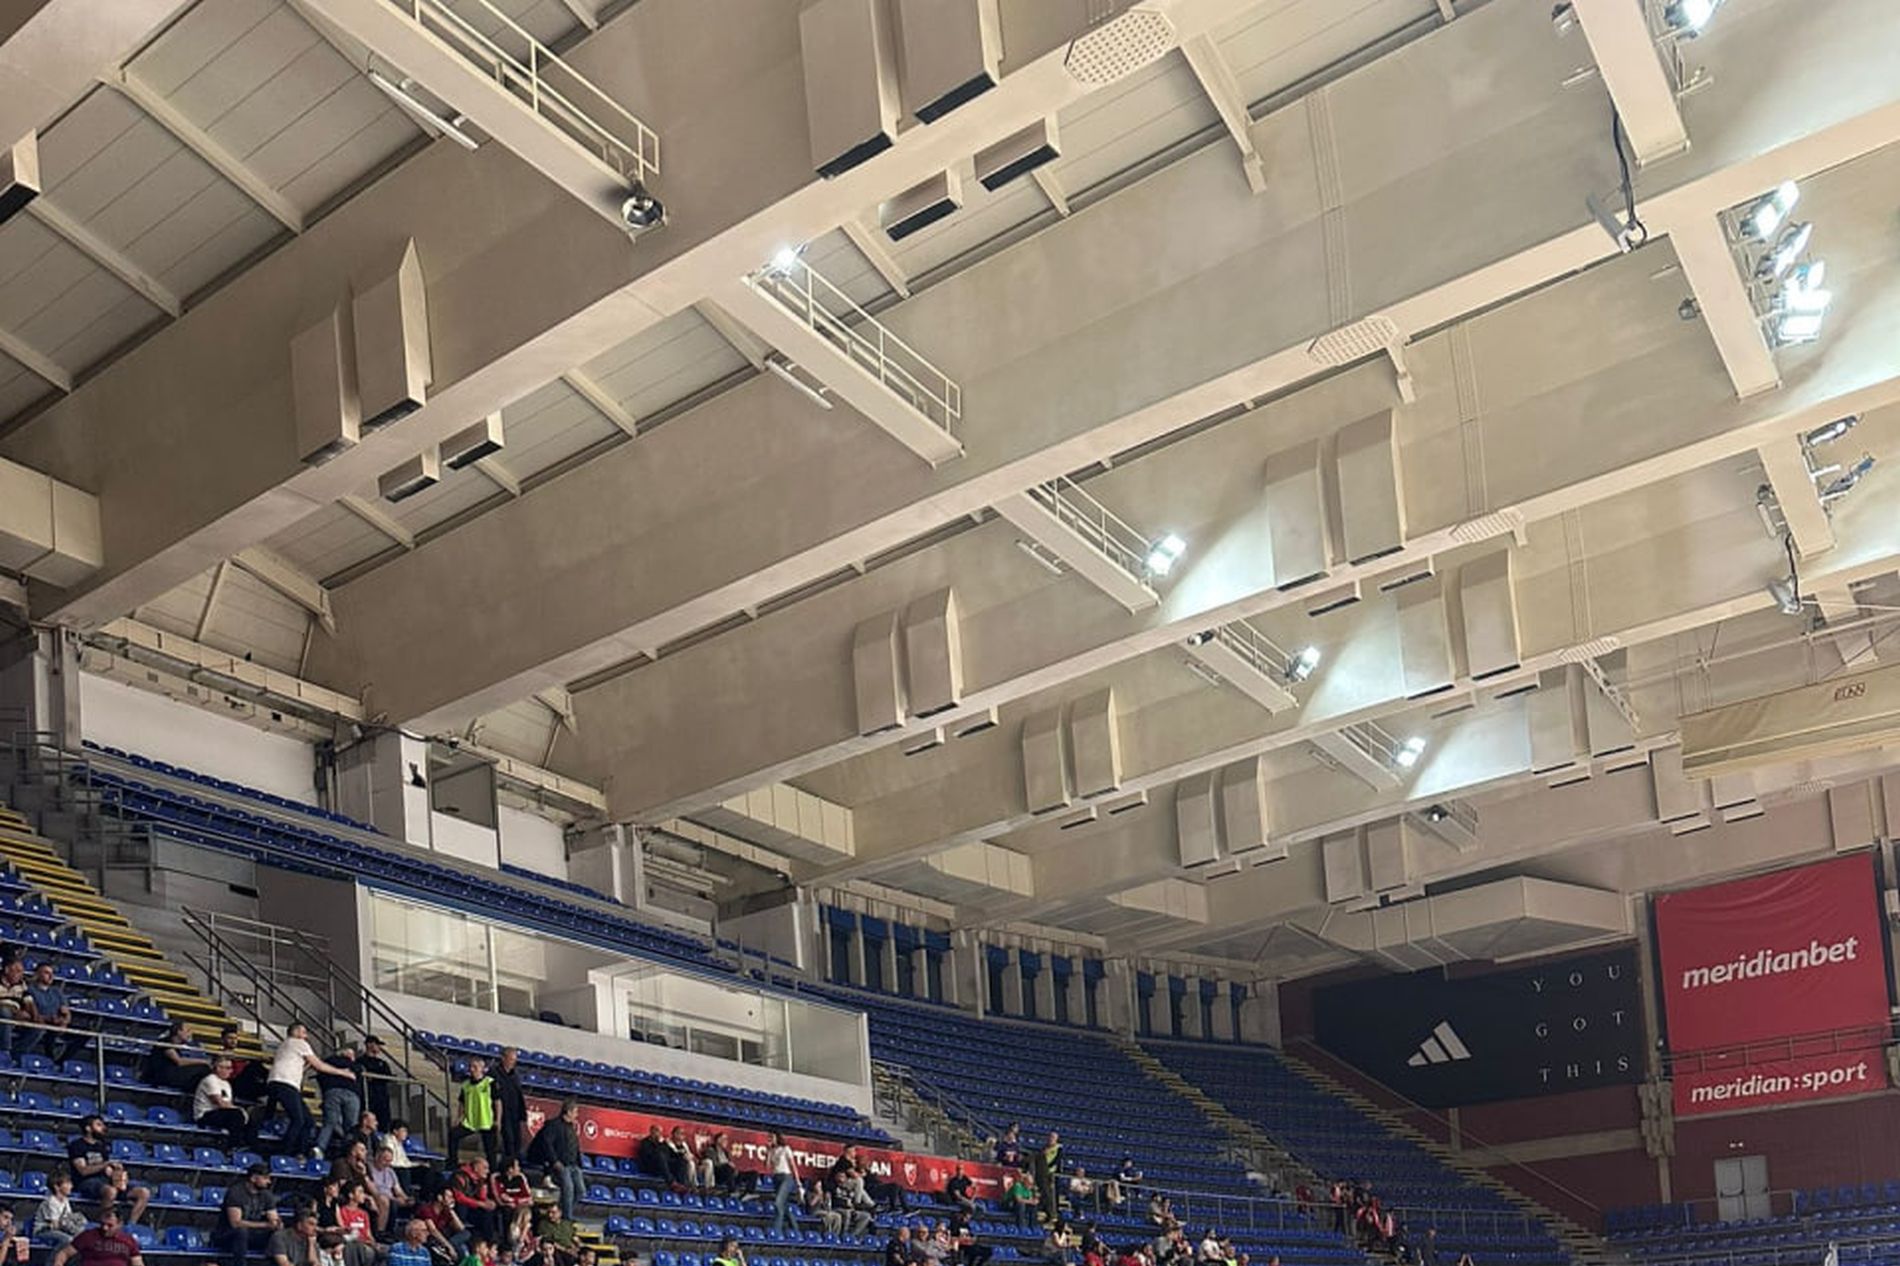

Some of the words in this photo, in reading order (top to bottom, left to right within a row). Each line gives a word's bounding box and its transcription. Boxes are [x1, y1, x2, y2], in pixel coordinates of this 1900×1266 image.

[1682, 937, 1858, 989] meridianbet
[1533, 964, 1621, 993] YOU
[1535, 1010, 1624, 1037] GOT
[1540, 1056, 1629, 1083] THIS
